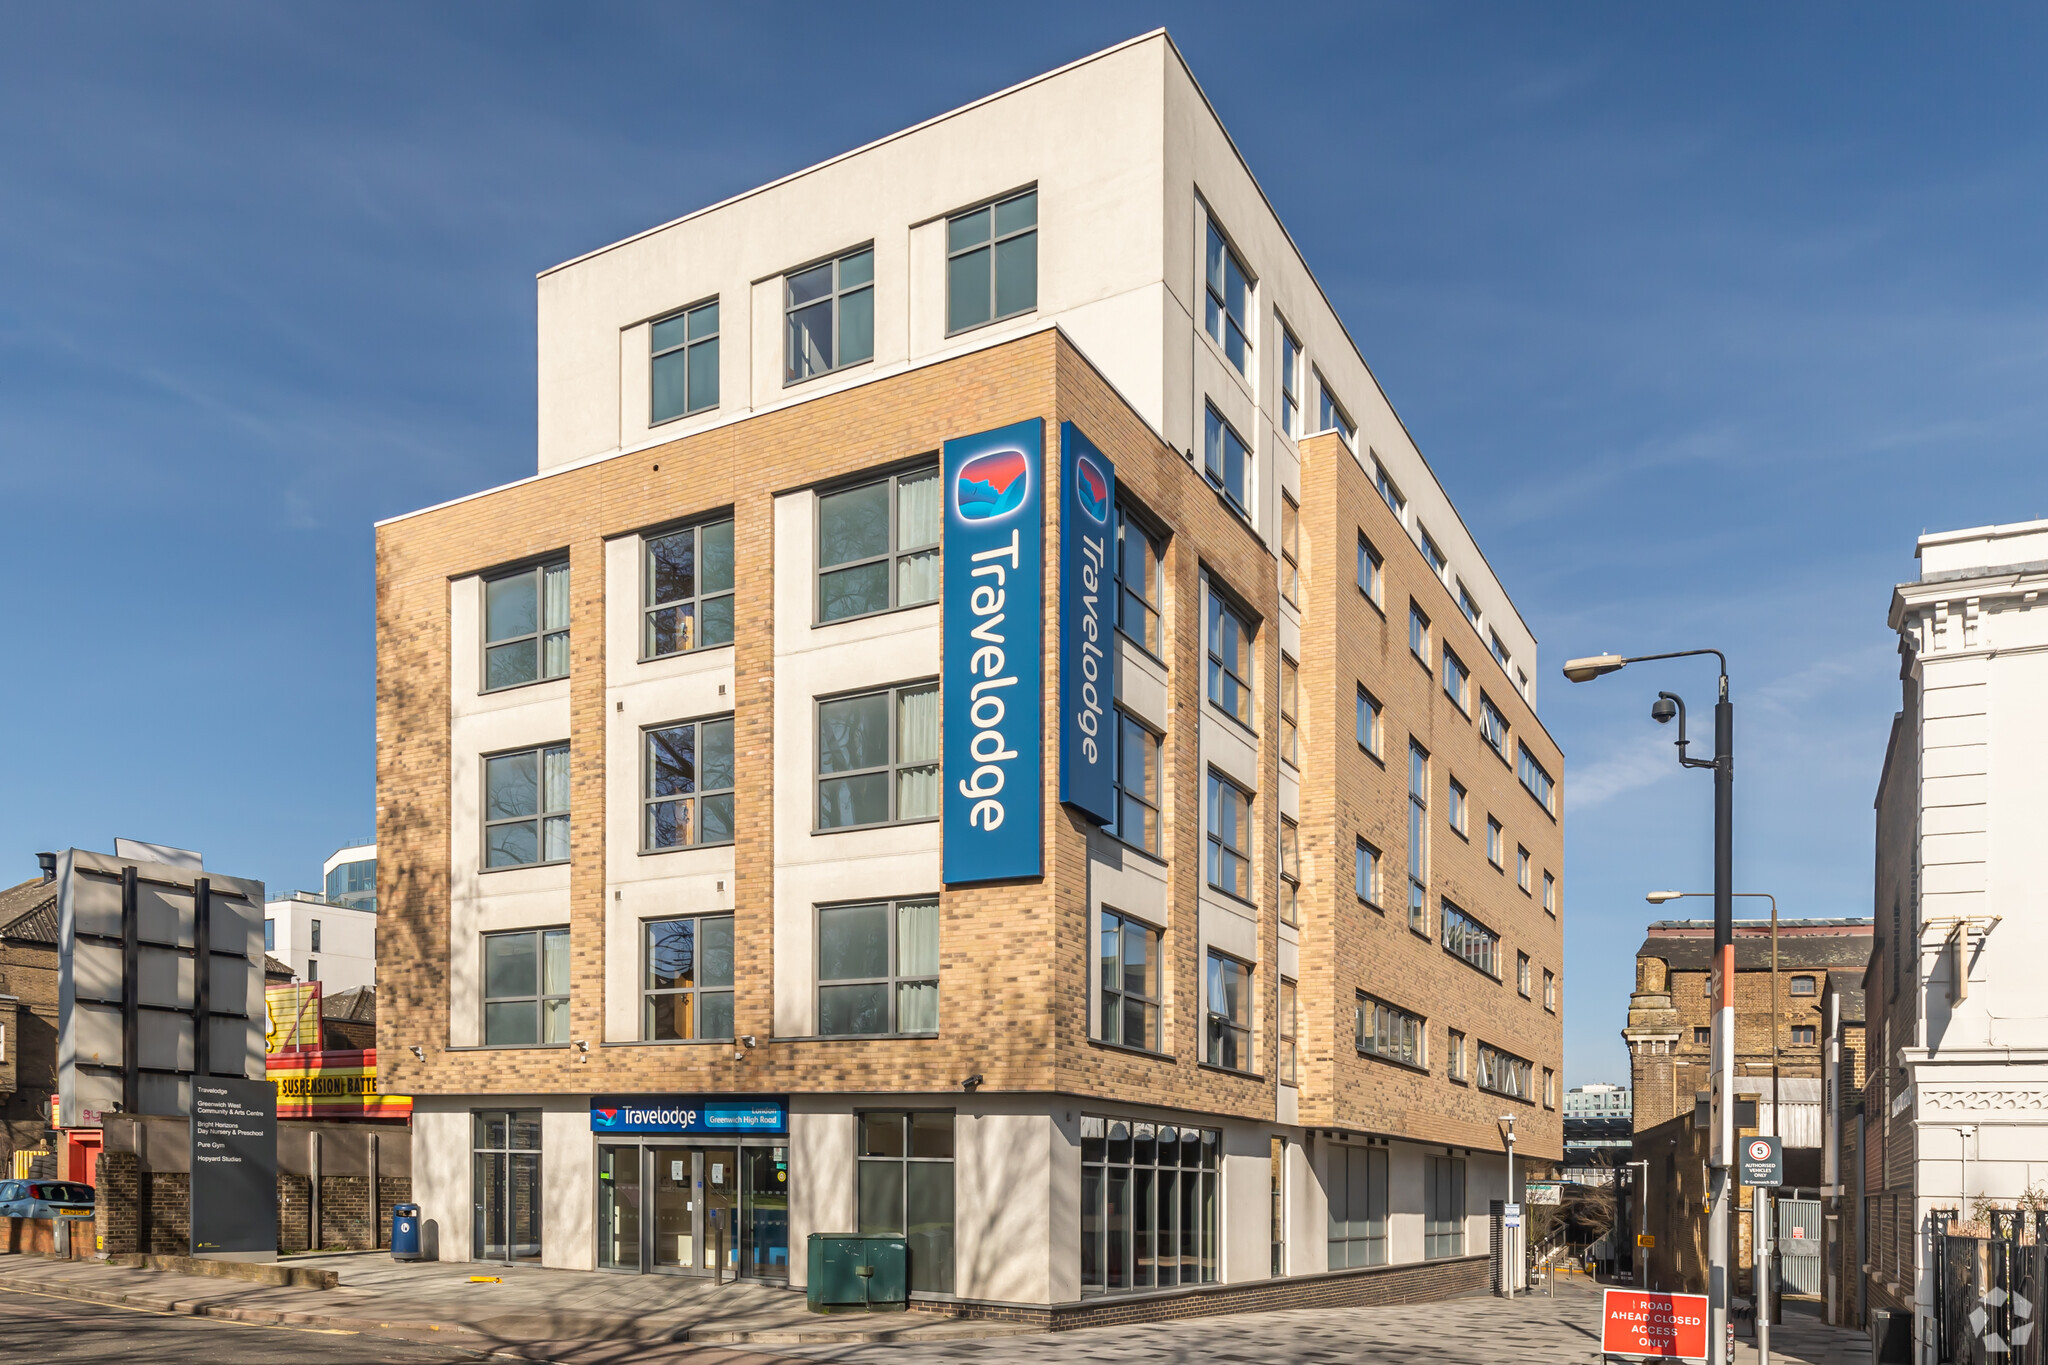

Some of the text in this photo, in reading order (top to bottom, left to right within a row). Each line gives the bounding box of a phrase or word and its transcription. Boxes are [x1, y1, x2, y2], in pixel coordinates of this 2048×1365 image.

[1076, 535, 1104, 765] Travelodge
[959, 529, 1019, 832] Travelodge
[283, 1077, 340, 1094] SUSPENSION
[347, 1076, 376, 1093] BATTE
[197, 1086, 228, 1095] Travelodge
[197, 1100, 227, 1108] Greenwich
[197, 1107, 228, 1116] Community
[751, 1106, 777, 1114] London
[622, 1105, 696, 1128] Travelodge
[709, 1116, 777, 1126] Greenwich High Road
[197, 1121, 214, 1129] Bright
[197, 1128, 209, 1136] Day
[197, 1155, 220, 1163] Hopyard
[1640, 1301, 1672, 1311] ROAD
[1611, 1311, 1701, 1326] AHEAD CLOSED
[1631, 1325, 1678, 1336] ACCESS
[1638, 1337, 1670, 1348] ONLY
